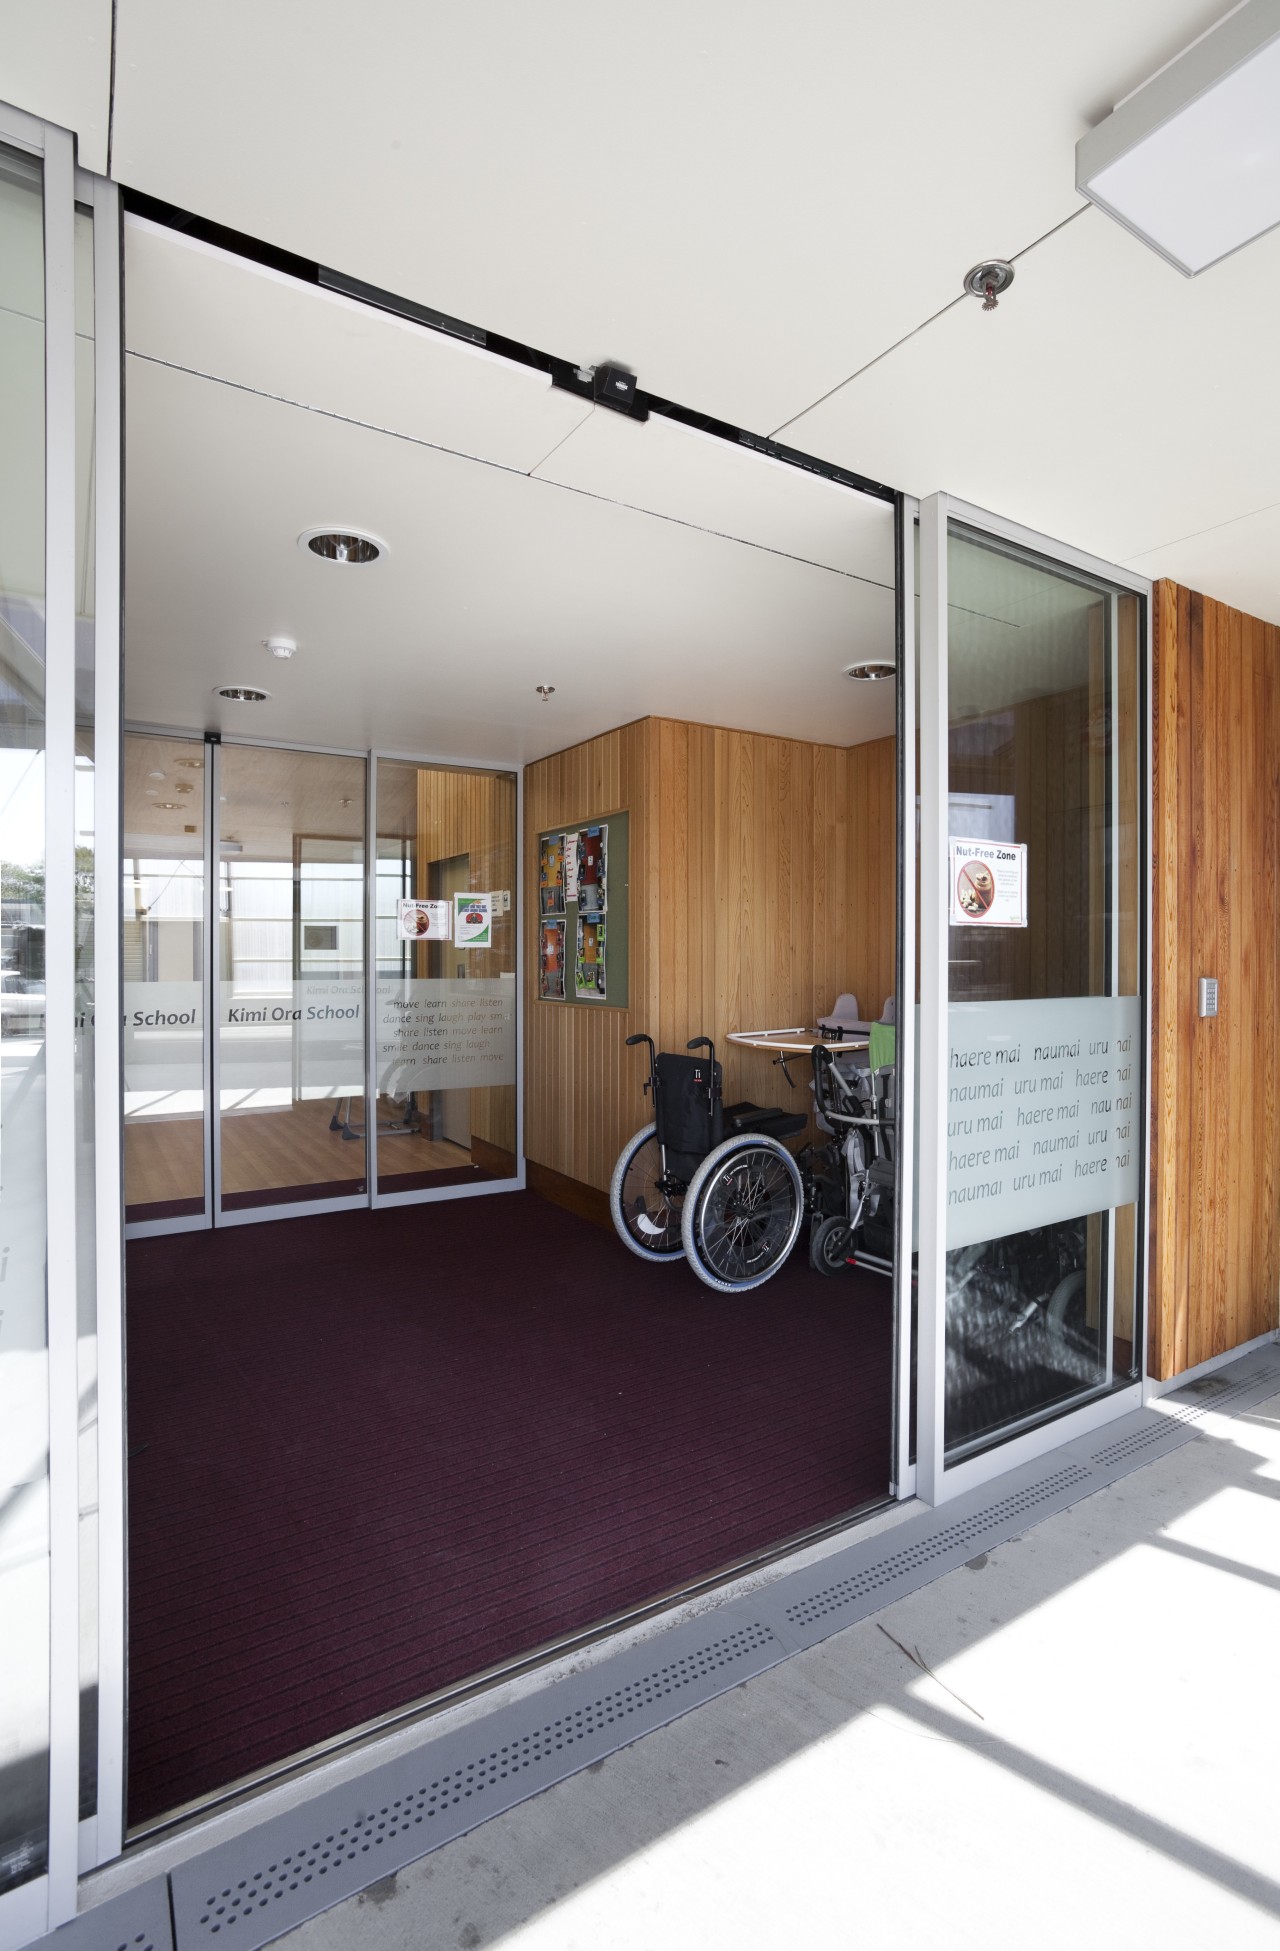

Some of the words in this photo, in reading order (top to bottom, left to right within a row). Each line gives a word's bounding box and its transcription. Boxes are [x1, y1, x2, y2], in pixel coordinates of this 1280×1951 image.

[956, 846, 995, 858] Nut-Free
[996, 850, 1016, 860] Zone
[393, 1000, 420, 1009] move
[424, 999, 447, 1008] learn
[451, 998, 475, 1008] share
[480, 998, 503, 1007] listen
[133, 1008, 196, 1027] School
[228, 1007, 267, 1022] Kimi
[271, 1007, 302, 1021] Ora
[306, 1004, 360, 1020] School
[383, 1014, 412, 1024] dance
[415, 1014, 435, 1025] sing
[438, 1013, 464, 1025] laugh
[467, 1012, 486, 1024] play
[393, 1028, 419, 1038] share
[423, 1027, 448, 1037] listen
[452, 1027, 477, 1036] move
[481, 1026, 503, 1035] learn
[412, 1041, 440, 1051] dance
[443, 1040, 462, 1052] sing
[466, 1039, 490, 1051] laugh
[950, 1047, 991, 1068] haere
[995, 1043, 1021, 1065] mai
[1033, 1039, 1081, 1061] naumai
[1089, 1041, 1109, 1056] uru
[422, 1056, 448, 1065] share
[452, 1054, 476, 1064] listen
[480, 1053, 504, 1062] move
[949, 1077, 1004, 1103] naumai
[1014, 1078, 1036, 1095] uru
[1040, 1071, 1064, 1092] mai
[1075, 1068, 1109, 1087] haere
[947, 1118, 972, 1137] uru
[976, 1110, 1003, 1133] mai
[1016, 1107, 1054, 1127] haere
[1056, 1099, 1080, 1121] mai
[949, 1149, 990, 1172] haere
[994, 1140, 1020, 1163] mai
[1033, 1130, 1080, 1156] naumai
[1088, 1129, 1108, 1145] uru
[948, 1180, 1003, 1206] naumai
[1012, 1173, 1036, 1191] uru
[1039, 1163, 1063, 1186] mai
[1074, 1159, 1108, 1178] haere
